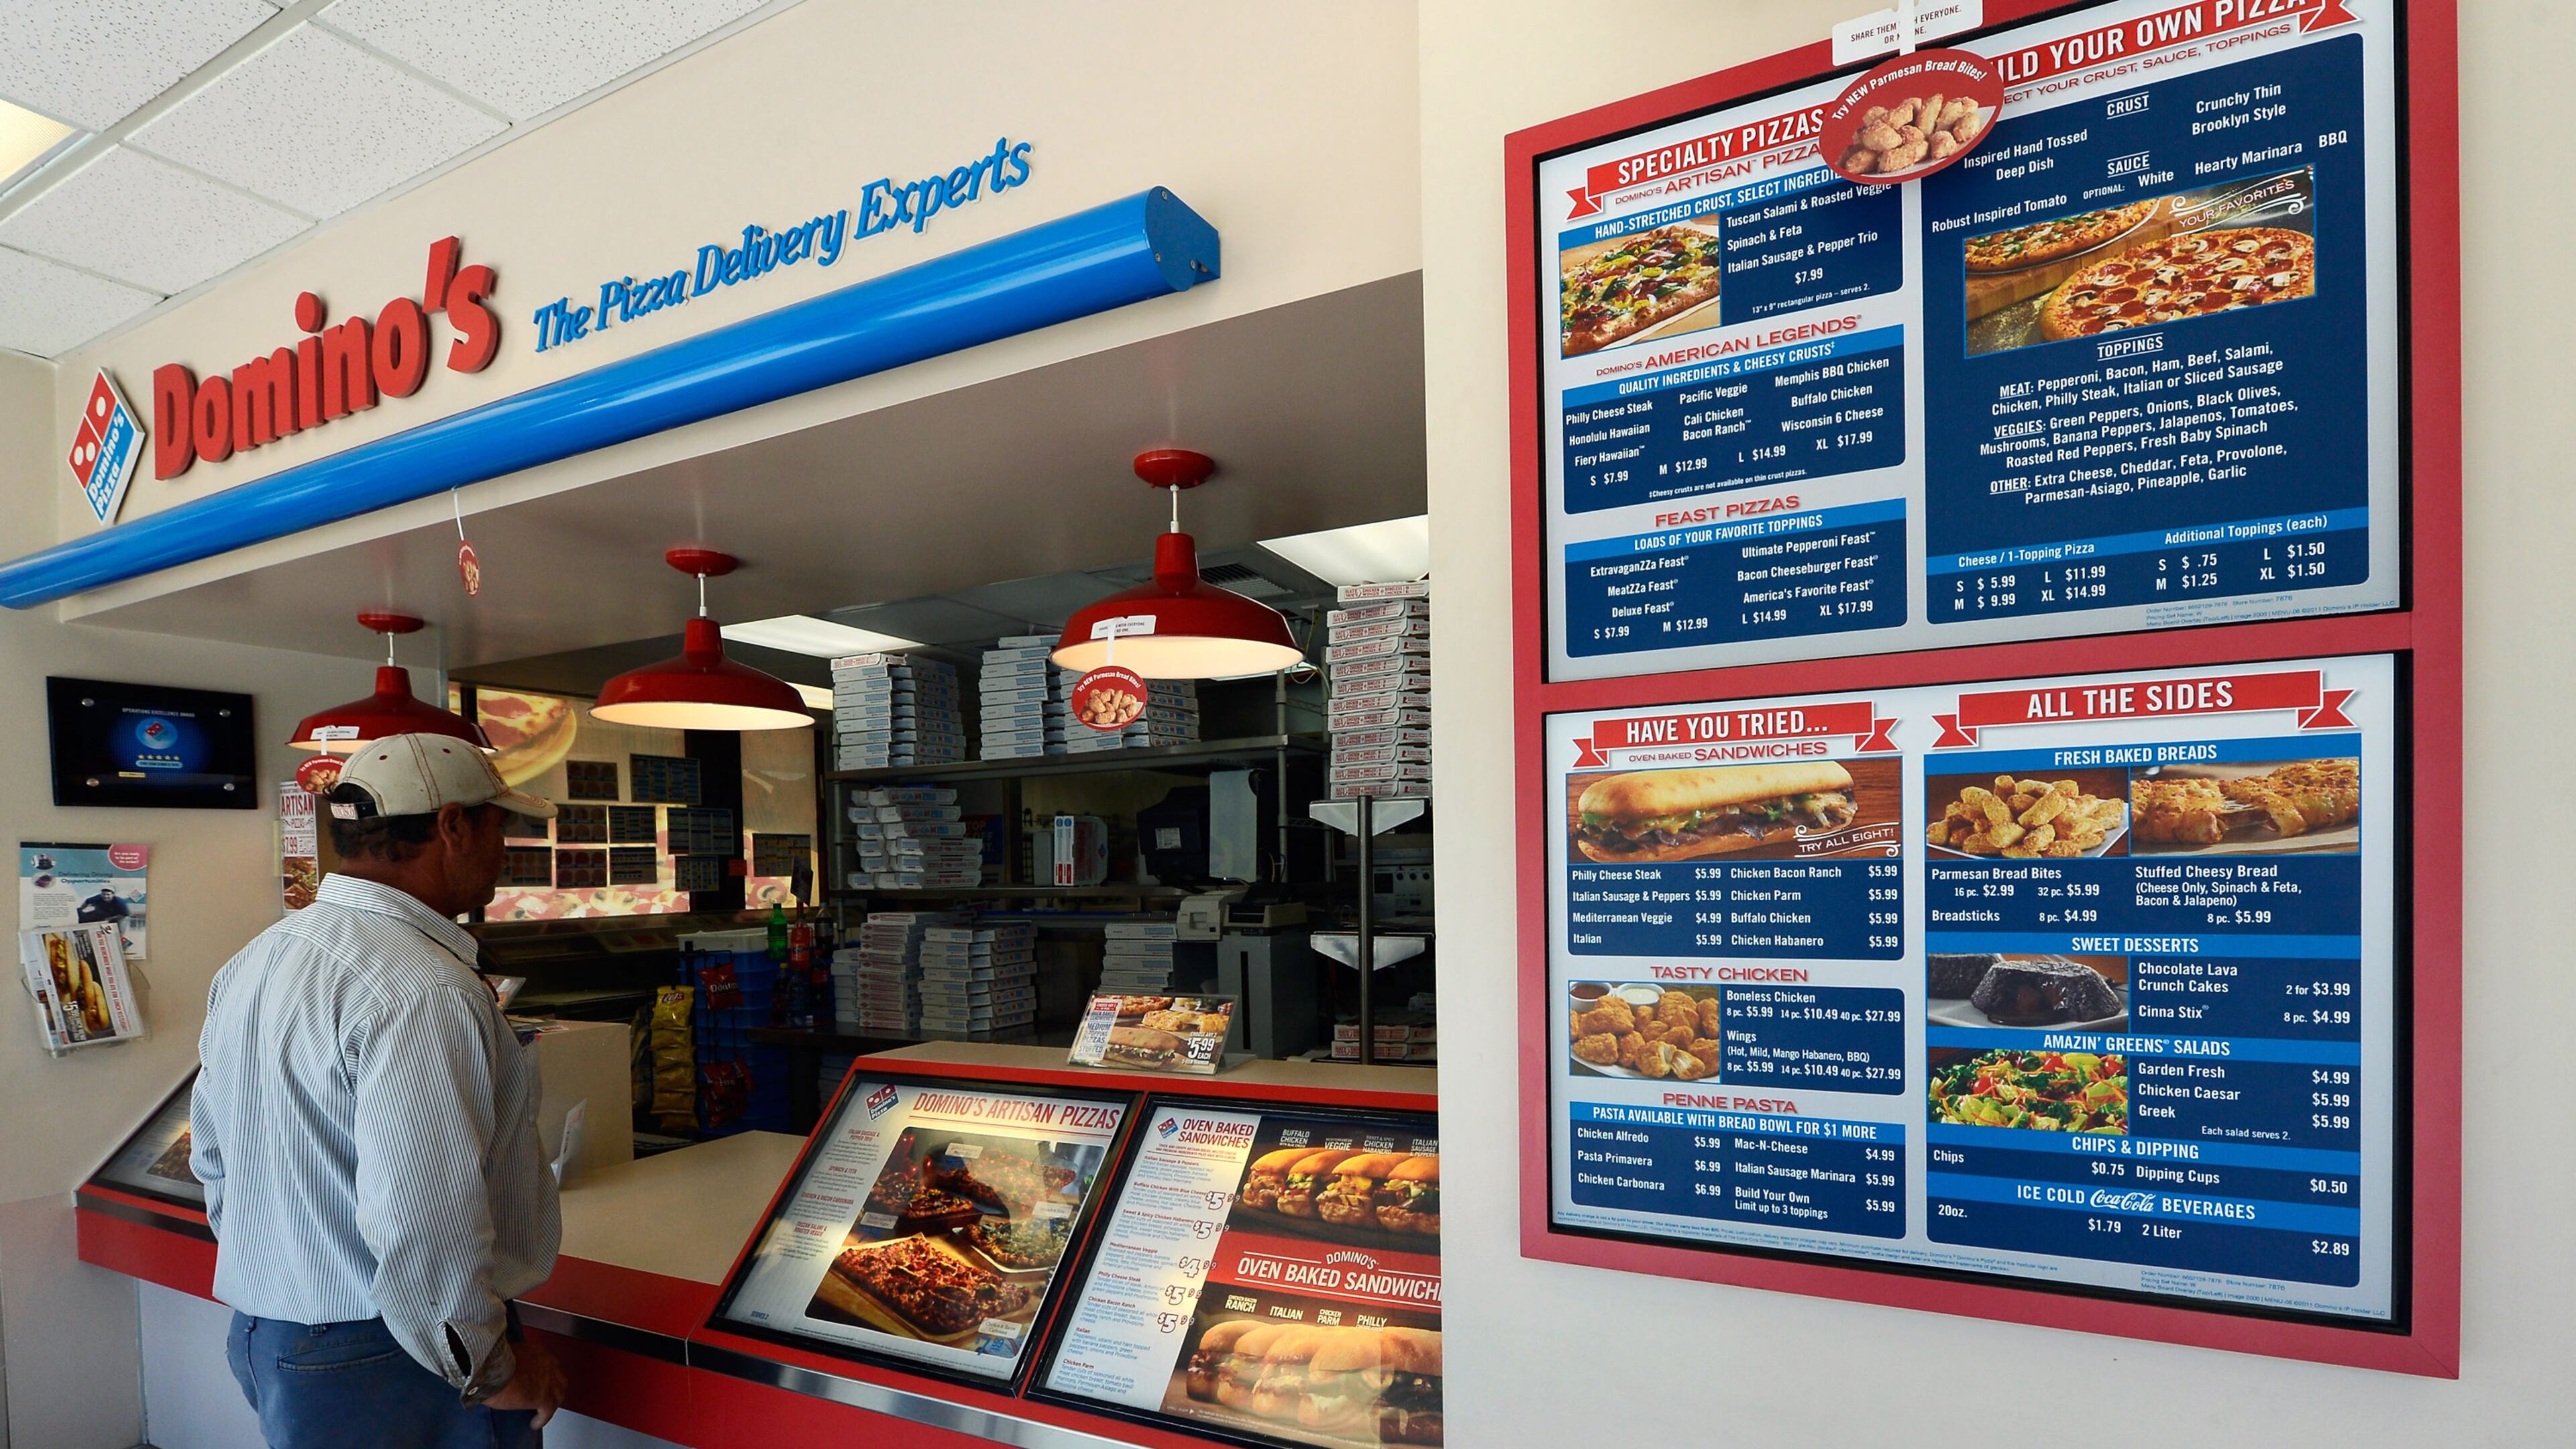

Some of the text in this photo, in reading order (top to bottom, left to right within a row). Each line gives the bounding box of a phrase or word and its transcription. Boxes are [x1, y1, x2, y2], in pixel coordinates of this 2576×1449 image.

[1851, 5, 1962, 42] SHARE THEM EVERYONE.
[1884, 34, 1895, 44] OR
[2049, 6, 2202, 69] YOUR OWN
[2037, 23, 2291, 95] YOUR CRUST, SAUCE, TOPPINGS
[1832, 60, 1988, 121] Try NEW Parmesan Bread Bites!
[2196, 84, 2281, 113] Crunchy Thin
[2107, 95, 2149, 116] CRUST
[1618, 109, 1823, 184] SPECIALTY PIZZAS
[2318, 130, 2348, 148] BBQ
[1595, 162, 1843, 239] HAND-STRETCHED CRUST, SELECT INGREDI
[2180, 179, 2295, 227] YOUR FAVORITES
[533, 136, 1033, 353] The Pizza Delivery Experts
[1727, 225, 1802, 252] Spinach & Feta
[1728, 232, 1878, 274] Italian Sausage & Pepper Trio
[1794, 268, 1823, 285] $7.99
[1777, 296, 1814, 309] rectangular
[1815, 292, 1833, 302] pizza
[1840, 286, 1862, 296] serves
[154, 235, 498, 480] Domino's
[1596, 361, 1642, 376] DOMINO'S
[1644, 337, 1750, 370] AMERICAN
[2097, 336, 2163, 358] TOPPINGS
[1775, 358, 1889, 387] Memphis BBQ Chicken
[1999, 341, 2273, 400] MEAT: Pepperoni, Bacon, Ham, Beef, Salami,
[1679, 382, 1748, 405] Pacific Veggie
[1566, 400, 1653, 425] Philly Cheese Steak
[88, 413, 124, 501] Domino's
[1656, 495, 1800, 527] FEAST PIZZAS
[1634, 515, 1823, 551] LOADS OF YOUR FAVORITE TOPPINGS
[1077, 672, 1142, 692] Try NEW Parmesan Bread Bites!
[2027, 681, 2233, 718] ALL THE SIDES
[1627, 710, 1827, 743] HAVE YOU TRIED...
[1629, 741, 1827, 762] OVEN BAKED SANDWICHES
[2055, 744, 2217, 765] FRESH BAKED BREADS
[281, 794, 314, 816] ARTISAN
[1799, 828, 1894, 853] TRY ALL EIGHT!
[1932, 910, 2000, 922] Breadsticks
[2072, 936, 2199, 953] SWEET DESSERTS
[1650, 966, 1808, 982] TASTY CHICKEN
[1086, 1022, 1111, 1031] MEDIUM
[912, 1092, 987, 1116] DOMINO'S
[1059, 1105, 1120, 1130] PIZZAS
[1663, 1093, 1798, 1114] PENNE PASTA
[2139, 1104, 2176, 1118] Greek
[1183, 1118, 1254, 1136] OVEN BAKED
[1282, 1129, 1309, 1138] BUFFALO
[1178, 1131, 1250, 1149] SANDWICHES
[1280, 1136, 1308, 1144] CHICKEN
[1324, 1142, 1352, 1151] VEGGIE
[1362, 1146, 1393, 1155] HABANERO
[1364, 1140, 1394, 1149] CHICKEN
[1412, 1138, 1439, 1147] ITALIAN
[1735, 1138, 1808, 1154] Mac-N-Cheese
[2072, 1136, 2199, 1159] CHIPS & DIPPING
[1933, 1149, 1964, 1165] Chips
[1938, 1204, 1968, 1218] 20oz.
[2017, 1185, 2255, 1220] ICE COLD Coca-Cola BEVERAGES
[2312, 1239, 2349, 1256] $2.89
[1326, 1251, 1377, 1270] DOMINO'S
[1237, 1257, 1440, 1302] OVEN BAKED SANDWICH
[1088, 1296, 1106, 1304] Chicken
[1121, 1301, 1136, 1309] Ranch
[1225, 1299, 1256, 1313] RANCH
[1269, 1305, 1304, 1321] ITALIAN
[1319, 1309, 1342, 1317] CHICKEN
[1317, 1314, 1341, 1326] PARM
[1356, 1314, 1388, 1328] PHILLY
[1063, 1358, 1095, 1370] Chicken Parm
